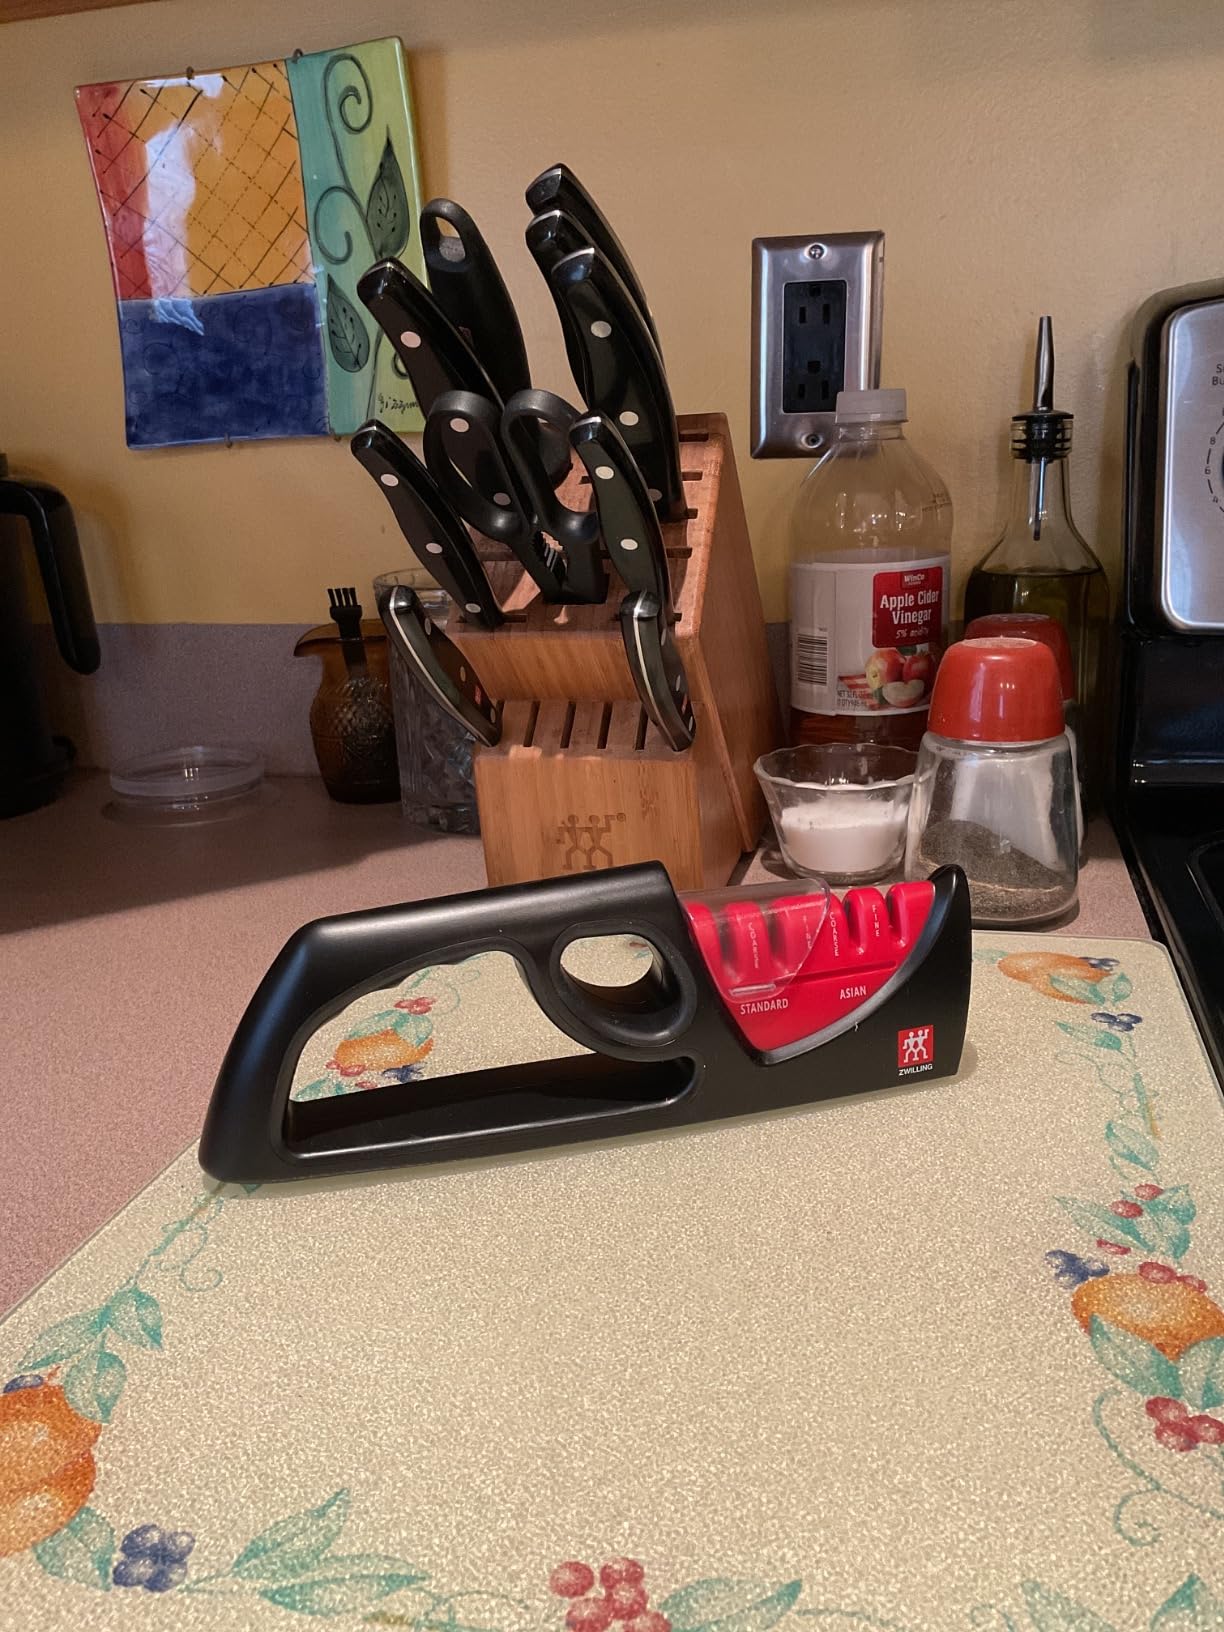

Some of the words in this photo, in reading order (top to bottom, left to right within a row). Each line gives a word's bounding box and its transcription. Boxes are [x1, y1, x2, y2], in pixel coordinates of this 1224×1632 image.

[1209, 436, 1216, 445] 8
[904, 573, 925, 583] WinCo
[880, 594, 915, 611] Apple
[918, 590, 939, 605] Cider
[892, 608, 932, 626] Vinegar
[896, 628, 908, 639] 5%
[872, 904, 880, 937] FINE
[829, 911, 839, 957] COARSE
[839, 985, 867, 1000] ASIAN
[740, 998, 789, 1015] STANDARD
[898, 1063, 933, 1076] ZWILLING
